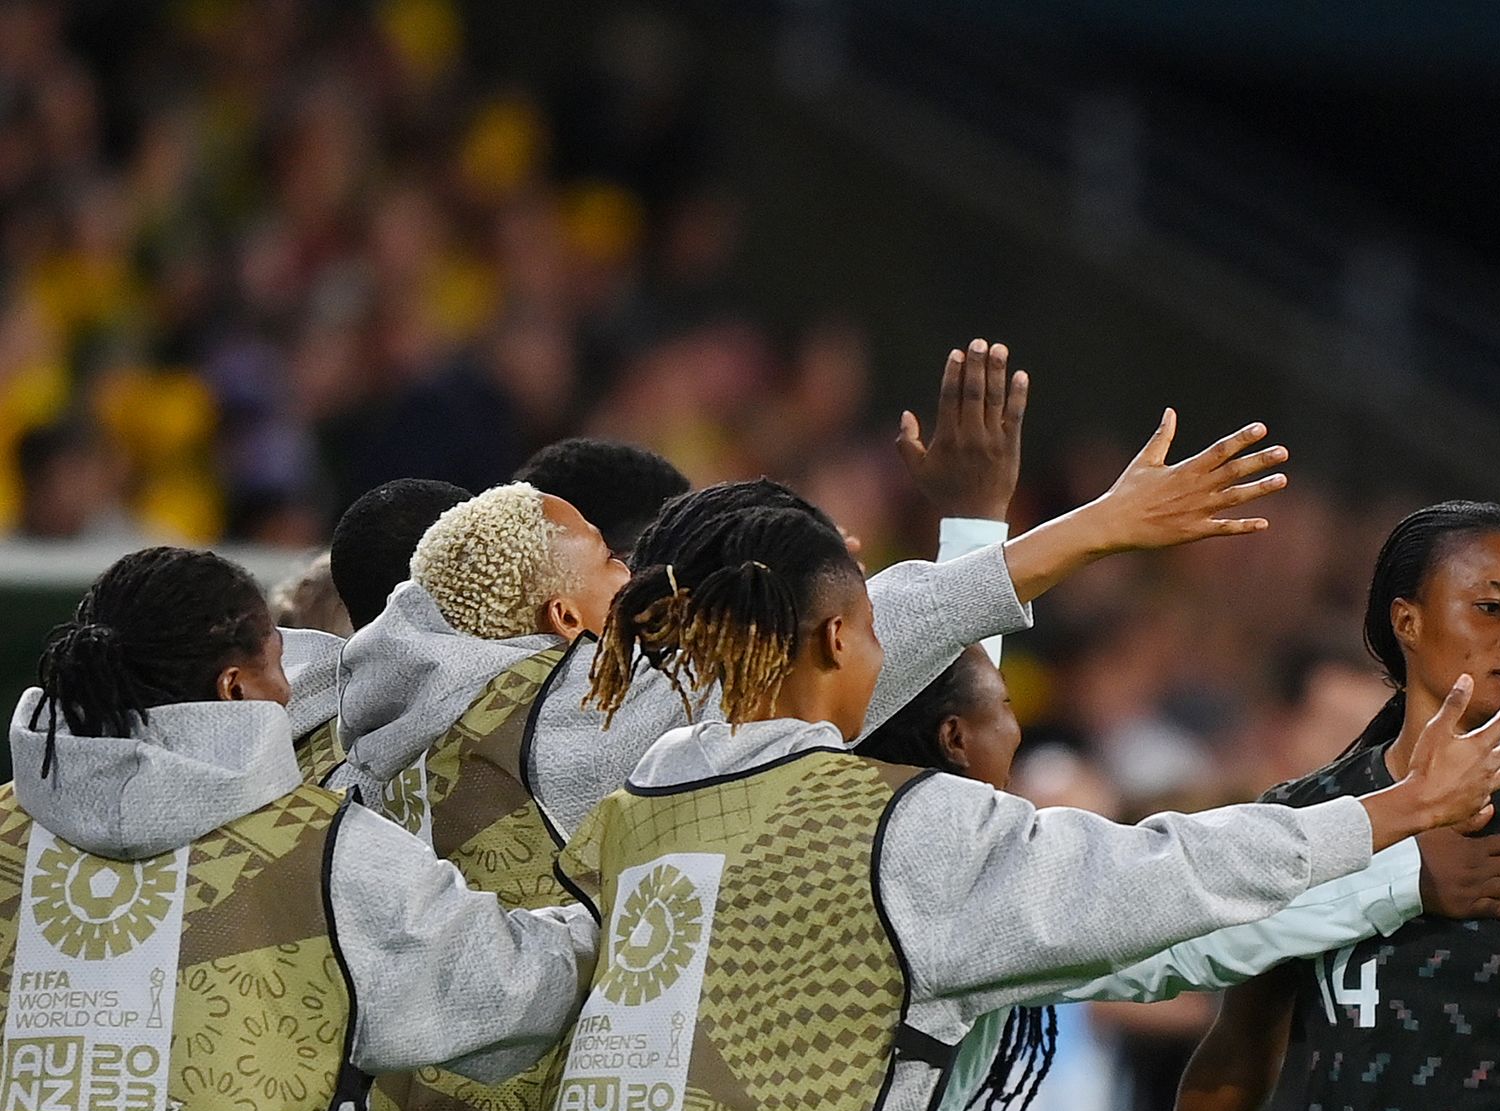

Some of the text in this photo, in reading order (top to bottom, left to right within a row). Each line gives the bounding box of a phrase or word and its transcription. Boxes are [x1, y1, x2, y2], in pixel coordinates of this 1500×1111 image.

[20, 970, 70, 991] FIFA
[17, 991, 119, 1010] WOMEN'S
[15, 1010, 139, 1029] WORLD CUP
[578, 1015, 612, 1033] FIFA
[573, 1033, 648, 1051] WOMEN'S
[12, 1042, 160, 1079] AU 20
[569, 1052, 661, 1071] WORLD CUP
